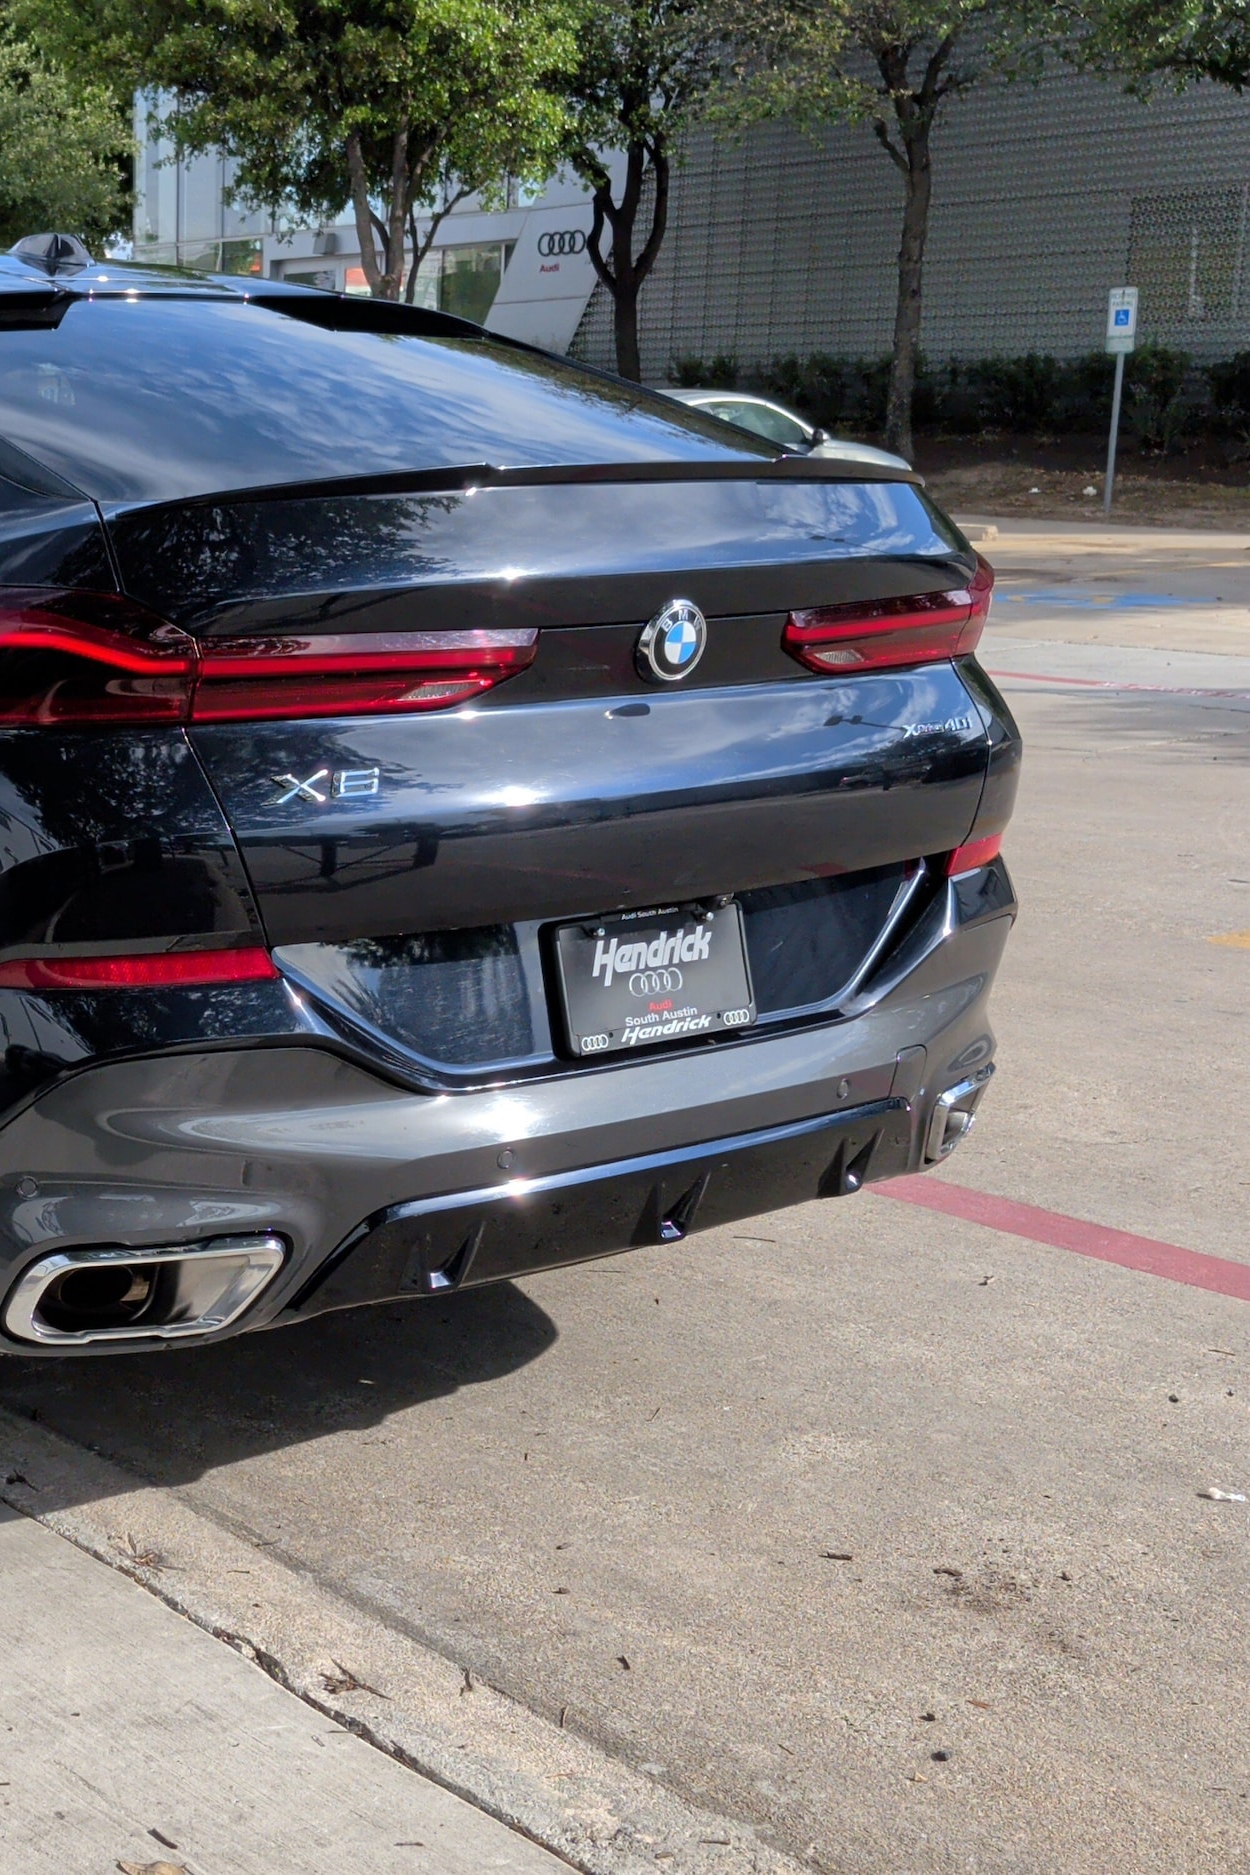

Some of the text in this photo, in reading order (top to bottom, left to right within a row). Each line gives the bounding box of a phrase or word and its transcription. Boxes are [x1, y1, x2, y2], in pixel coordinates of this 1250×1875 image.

[539, 263, 560, 273] Audi
[660, 608, 702, 634] BMW
[260, 766, 381, 807] X6
[621, 906, 679, 921] Audi South Austin
[592, 925, 712, 987] Hendrick
[625, 1005, 698, 1027] South Austin
[648, 998, 674, 1011] Audi
[620, 1014, 712, 1045] Hendrick
